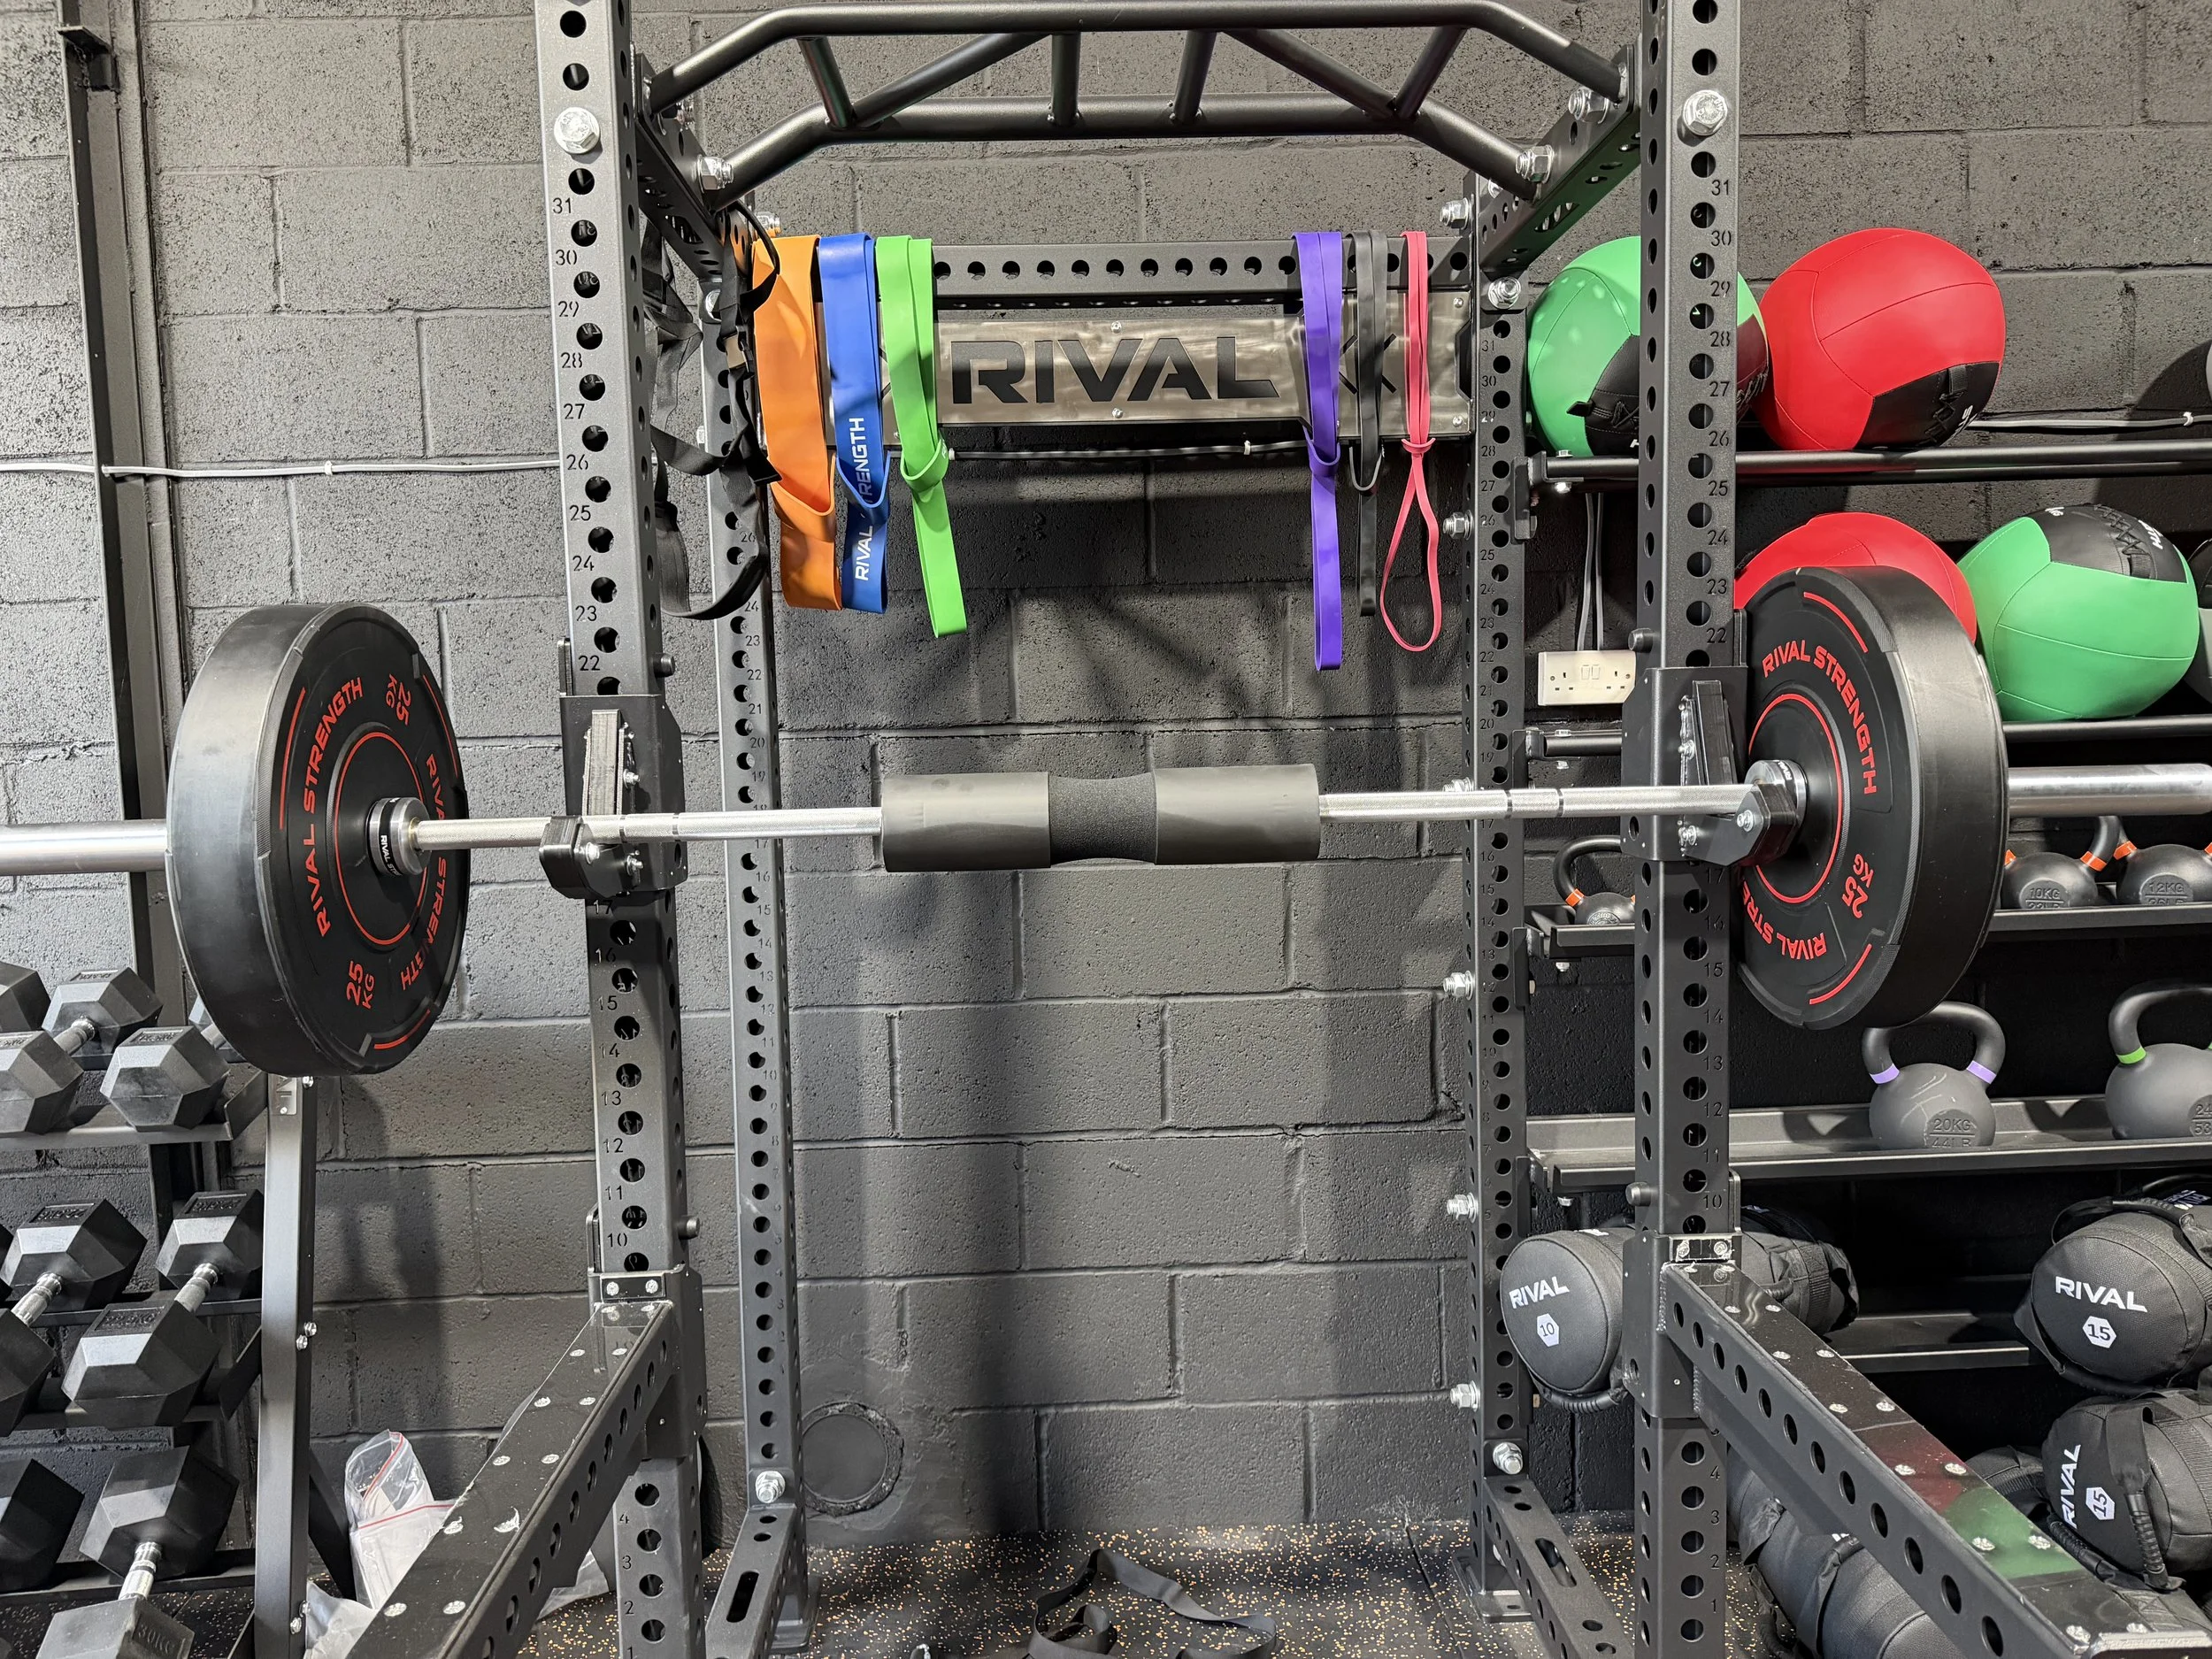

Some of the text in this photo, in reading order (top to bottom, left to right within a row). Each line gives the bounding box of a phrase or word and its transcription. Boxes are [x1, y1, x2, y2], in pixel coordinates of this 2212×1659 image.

[1711, 180, 1729, 196] 31
[552, 197, 572, 214] 31
[1710, 230, 1732, 247] 30
[556, 250, 577, 265] 30
[1710, 280, 1731, 297] 29
[557, 301, 579, 317] 29
[1481, 340, 1494, 352] 31
[1709, 331, 1730, 348] 28
[561, 352, 582, 368] 28
[951, 336, 1279, 404] RIVAL
[1481, 375, 1496, 387] 30
[1709, 381, 1730, 397] 27
[564, 403, 585, 419] 27
[1481, 411, 1495, 423] 29
[1709, 431, 1729, 447] 26
[1481, 445, 1496, 457] 28
[566, 454, 588, 470] 26
[849, 418, 873, 503] RENGTH
[1481, 480, 1495, 491] 27
[1708, 480, 1728, 496] 25
[569, 505, 591, 521] 25
[1707, 530, 1727, 545] 24
[855, 526, 873, 580] RIVAL
[1480, 549, 1494, 561] 25
[572, 555, 595, 572] 24
[1480, 583, 1494, 595] 24
[1706, 579, 1726, 595] 23
[575, 605, 597, 621] 23
[744, 601, 759, 612] 24
[1480, 618, 1494, 629] 23
[745, 635, 760, 646] 23
[1706, 627, 1726, 643] 22
[578, 656, 601, 671] 22
[1480, 651, 1494, 663] 22
[747, 670, 762, 680] 22
[386, 673, 399, 708] KG
[1480, 686, 1493, 696] 21
[396, 682, 411, 726] 25
[749, 703, 762, 714] 21
[1480, 719, 1494, 730] 20
[1762, 640, 1878, 795] RIVAL STRENGTH
[750, 737, 764, 749] 20
[1480, 753, 1494, 763] 19
[751, 772, 765, 782] 19
[426, 753, 445, 820] RIVA
[303, 677, 364, 937] RIVAL STRENGTH
[1480, 818, 1494, 829] 17
[380, 834, 391, 863] RIVAL
[755, 839, 768, 849] 17
[1480, 851, 1494, 862] 16
[756, 872, 770, 882] 16
[1706, 867, 1725, 883] 17
[1852, 853, 1874, 888] KG
[1481, 884, 1494, 895] 15
[2029, 887, 2060, 900] 10KG
[2148, 882, 2185, 895] 12KG
[1841, 876, 1869, 918] 25
[757, 905, 771, 916] 15
[1481, 917, 1495, 927] 14
[1704, 916, 1724, 931] 16
[758, 938, 772, 949] 14
[1776, 932, 1827, 960] RIVAL
[595, 948, 616, 963] 16
[1481, 949, 1495, 960] 13
[759, 971, 773, 981] 13
[1703, 963, 1724, 978] 15
[346, 960, 364, 1005] 25
[1482, 982, 1495, 993] 12
[362, 973, 376, 1009] KG
[597, 995, 618, 1010] 15
[760, 1004, 775, 1015] 12
[1703, 1010, 1724, 1025] 14
[762, 1037, 774, 1048] 11
[599, 1043, 620, 1058] 14
[1702, 1056, 1723, 1071] 13
[601, 1091, 622, 1106] 13
[1703, 1102, 1723, 1118] 12
[1933, 1118, 1971, 1133] 20KG
[603, 1139, 624, 1153] 12
[1702, 1148, 1719, 1163] 11
[605, 1186, 623, 1201] 11
[1702, 1194, 1723, 1210] 10
[607, 1233, 628, 1248] 10
[1509, 1276, 1570, 1310] RIVAL
[2055, 1276, 2148, 1313] RIVAL
[1540, 1321, 1555, 1335] 10
[2087, 1323, 2110, 1341] 15
[1709, 1466, 1720, 1480] 4
[2061, 1443, 2082, 1529] RIVAL
[2093, 1491, 2108, 1517] 15
[1710, 1510, 1720, 1524] 3
[622, 1555, 632, 1570] 3
[1709, 1555, 1720, 1569] 2
[624, 1601, 634, 1615] 2
[1711, 1599, 1717, 1613] 1
